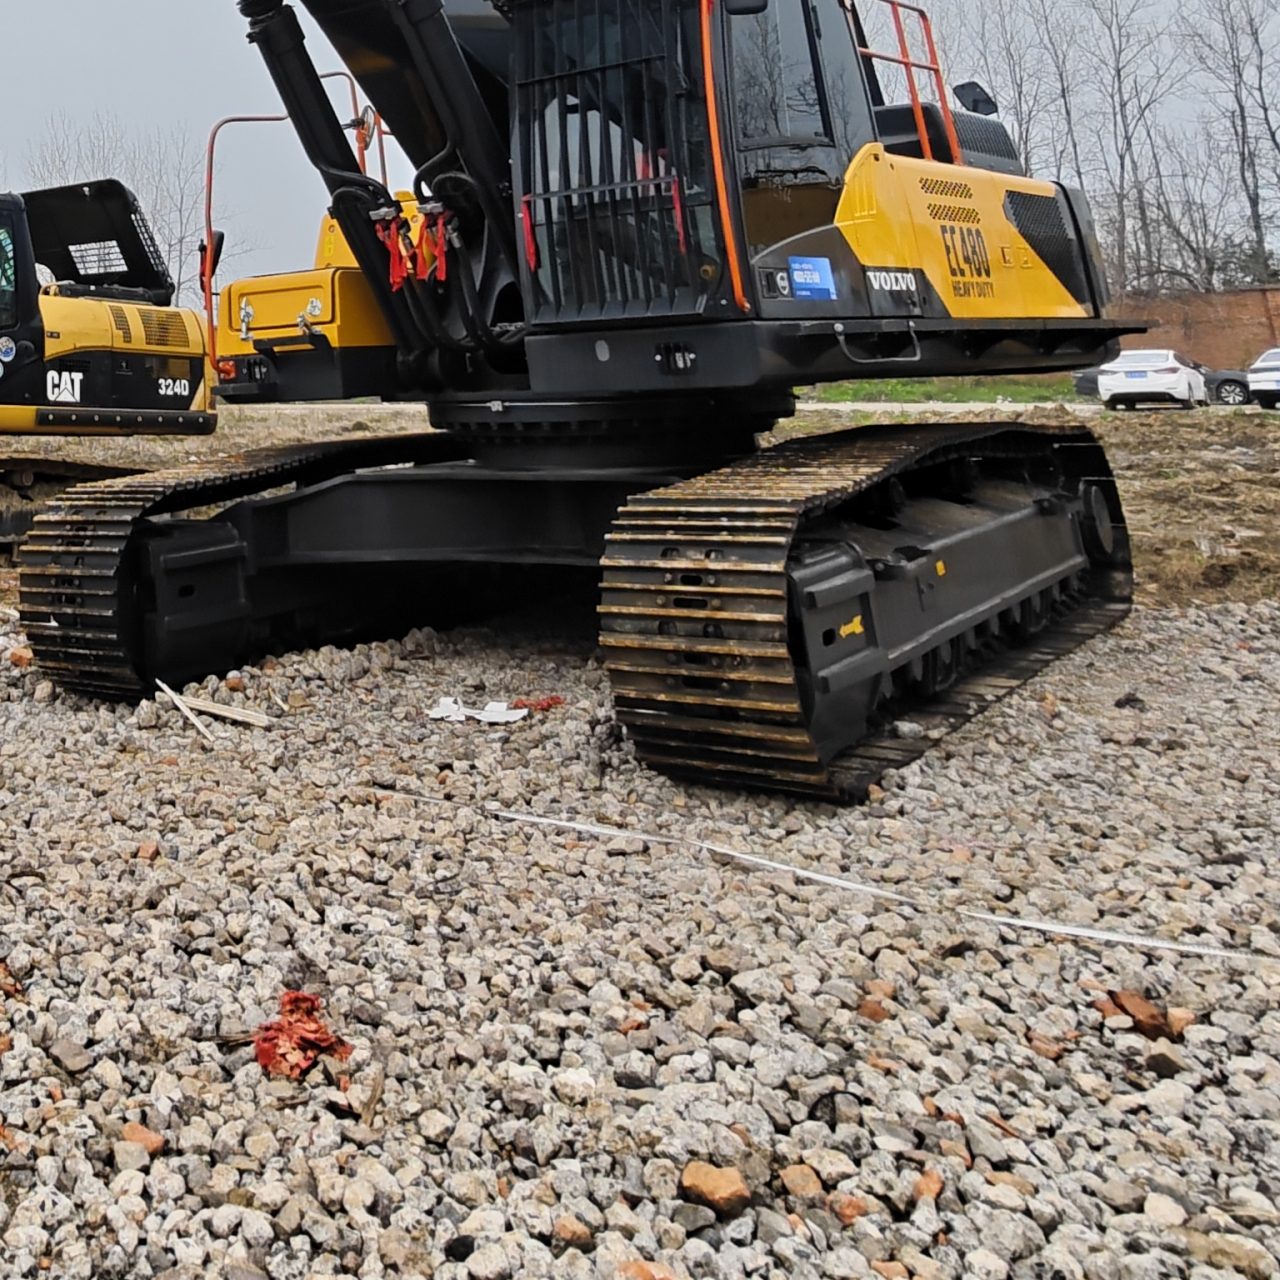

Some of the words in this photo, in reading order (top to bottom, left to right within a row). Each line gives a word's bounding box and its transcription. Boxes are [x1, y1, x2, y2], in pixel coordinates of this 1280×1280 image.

[940, 224, 991, 278] EC480
[866, 271, 916, 291] VOLVO
[951, 281, 976, 298] HEAVY
[976, 282, 995, 299] DUTY
[46, 370, 83, 402] CAT
[158, 378, 189, 396] 324D
